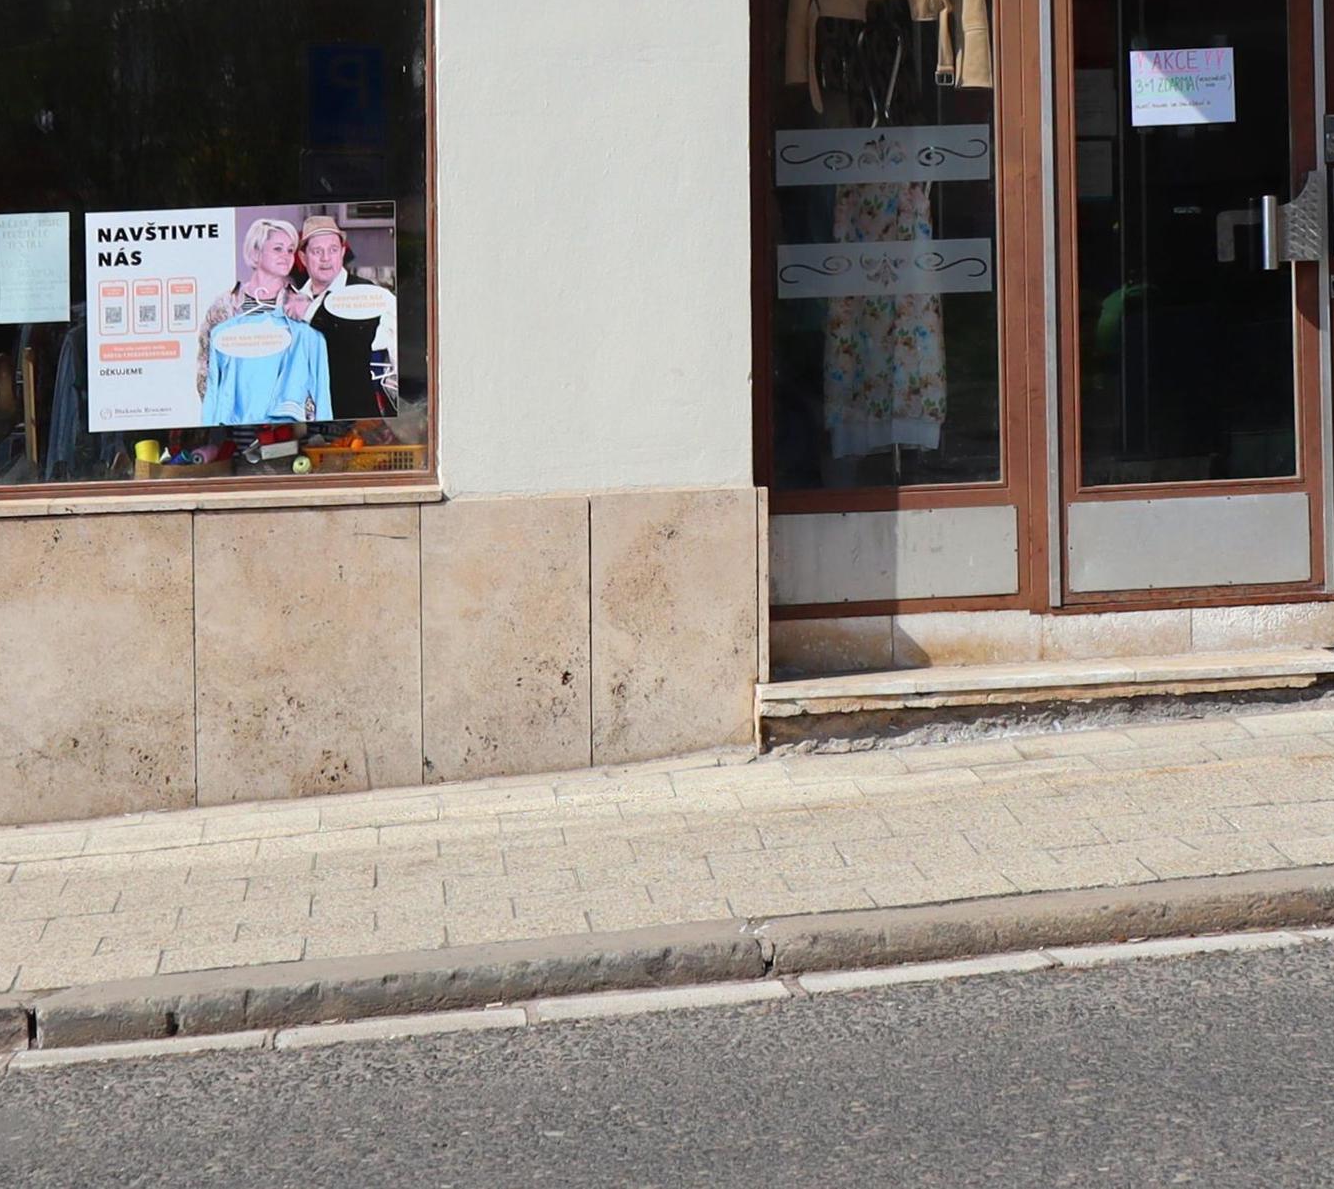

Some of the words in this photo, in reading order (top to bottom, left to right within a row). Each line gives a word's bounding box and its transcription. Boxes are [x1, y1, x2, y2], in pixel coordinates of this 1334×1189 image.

[1151, 50, 1198, 71] AKCE
[97, 221, 219, 243] NAVŠTIVTE
[98, 247, 143, 267] NÁS
[99, 367, 144, 377] DĚKUJEME
